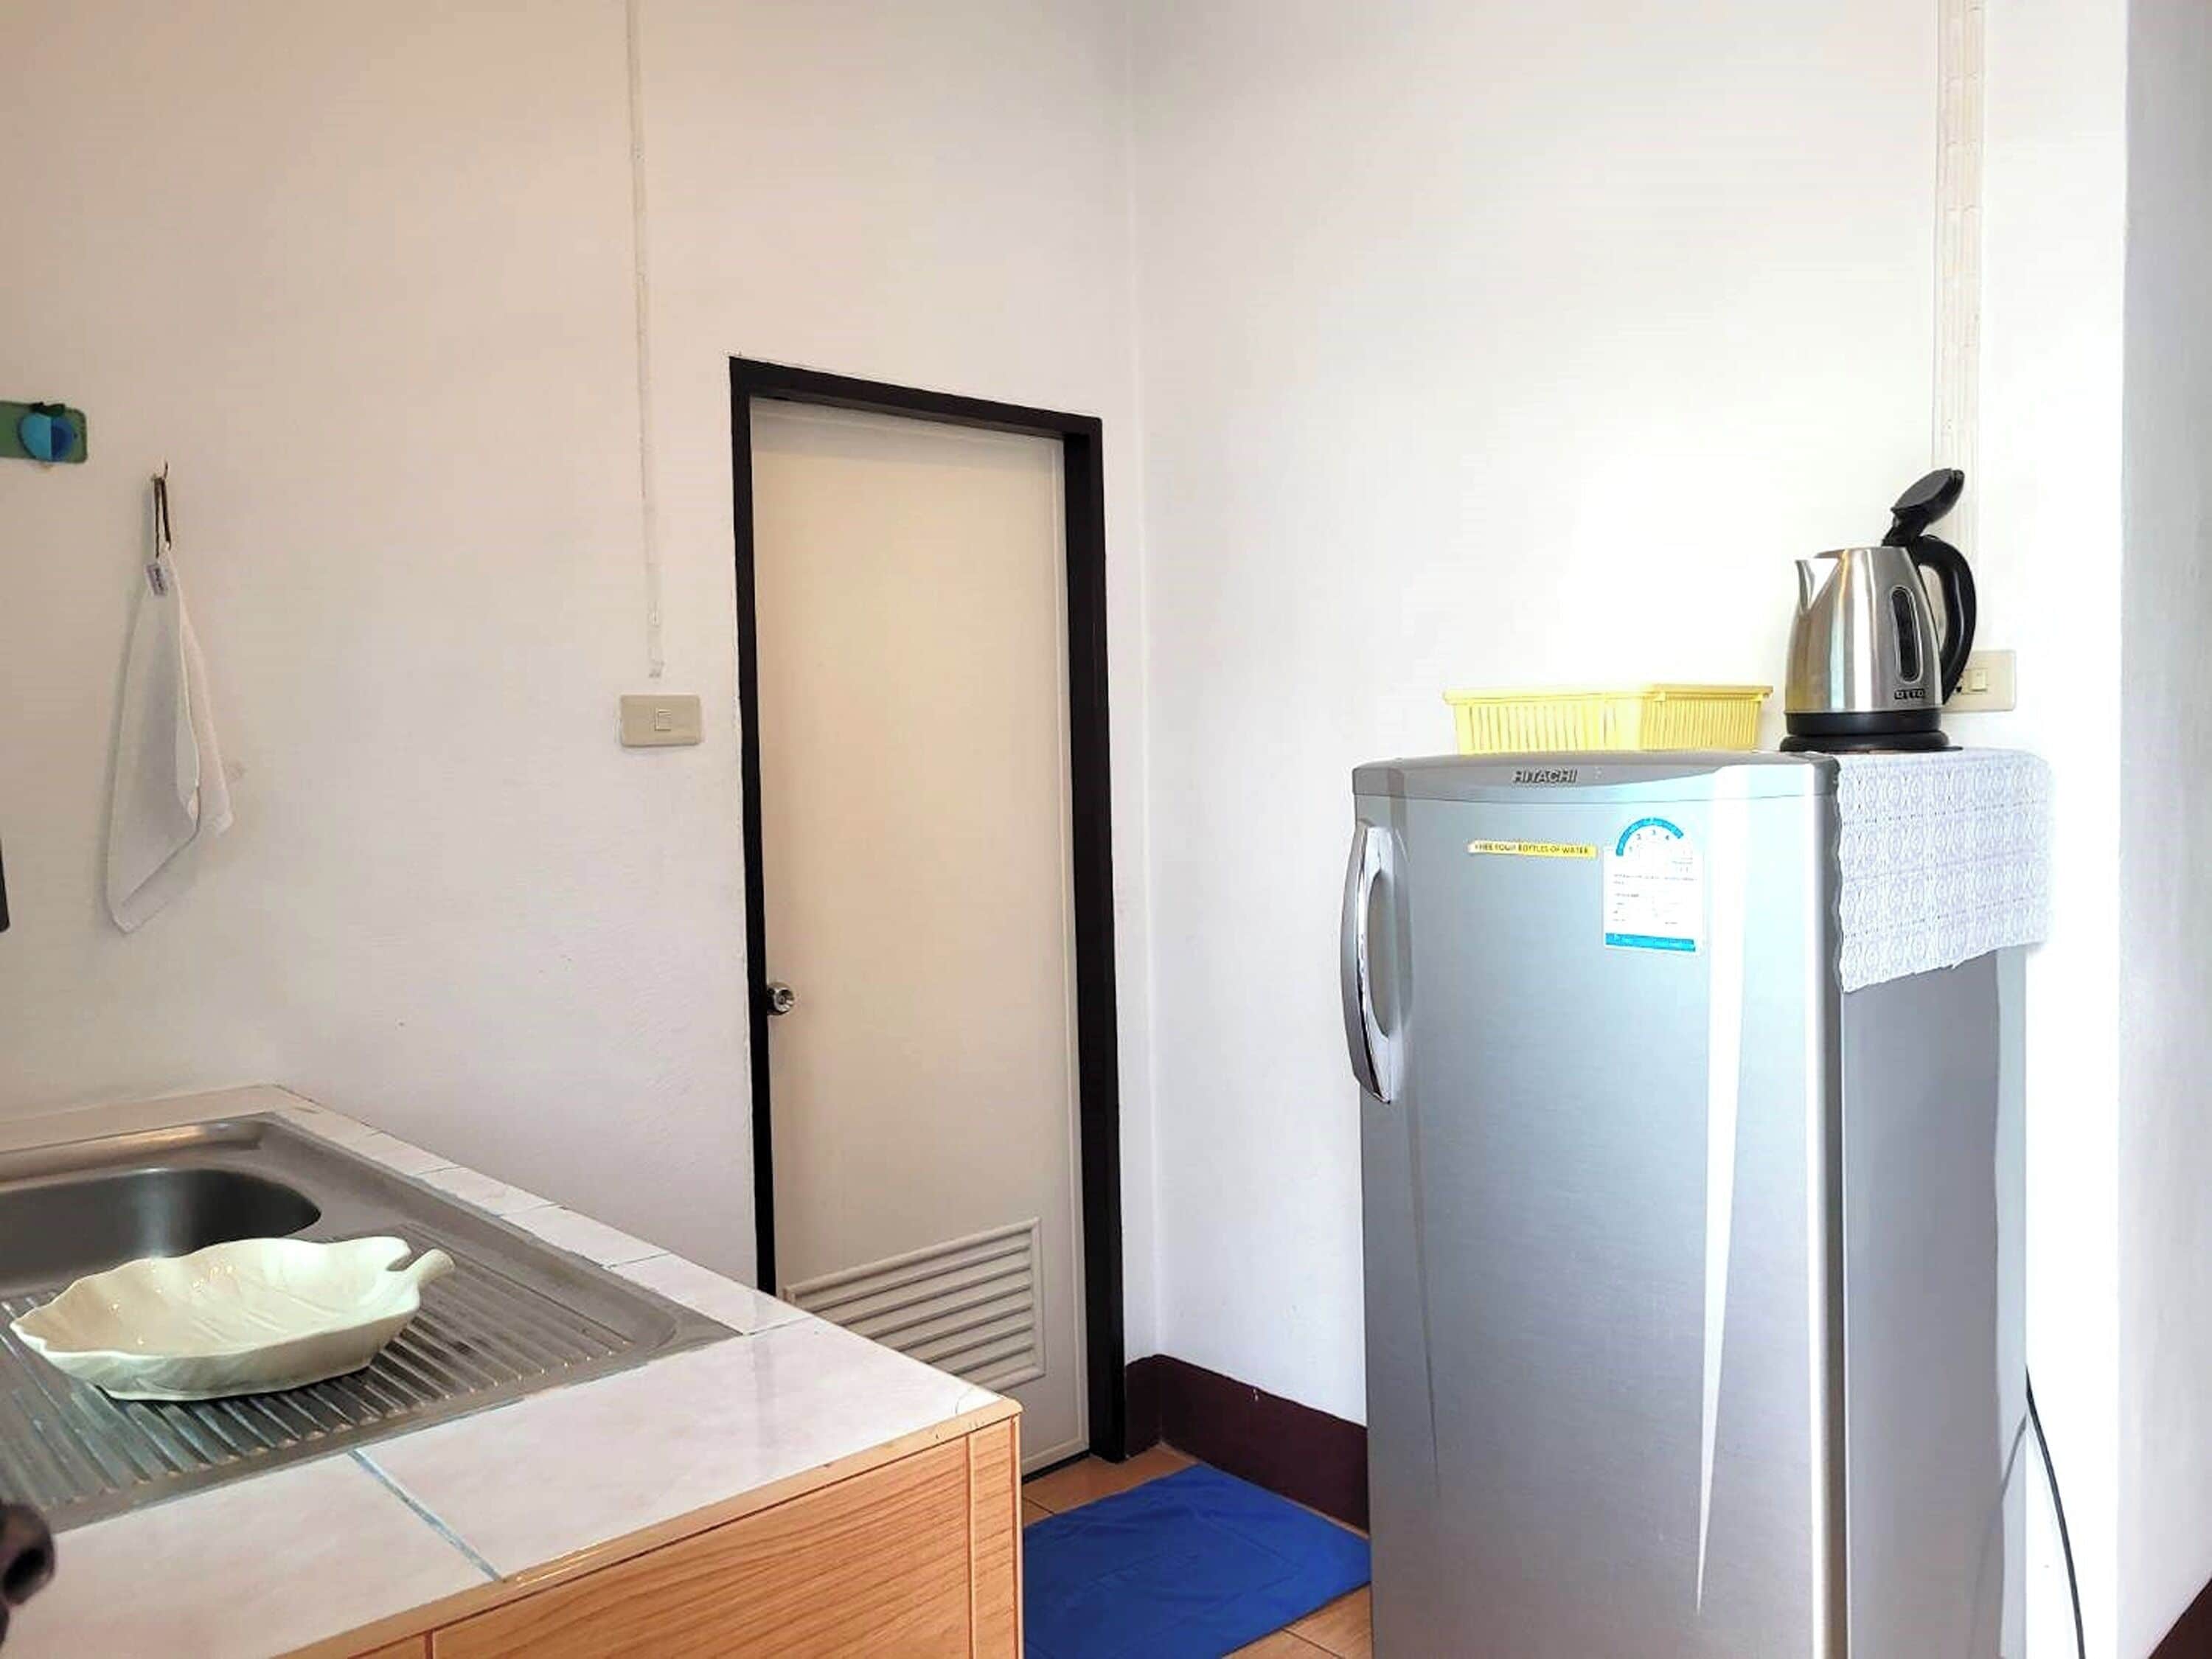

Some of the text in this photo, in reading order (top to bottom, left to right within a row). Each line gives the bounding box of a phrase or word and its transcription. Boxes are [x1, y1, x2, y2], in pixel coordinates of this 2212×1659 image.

[1512, 769, 1578, 783] HITACHI
[1517, 844, 1548, 853] BOTTLES
[1549, 845, 1560, 853] OF
[1561, 846, 1588, 855] WATER
